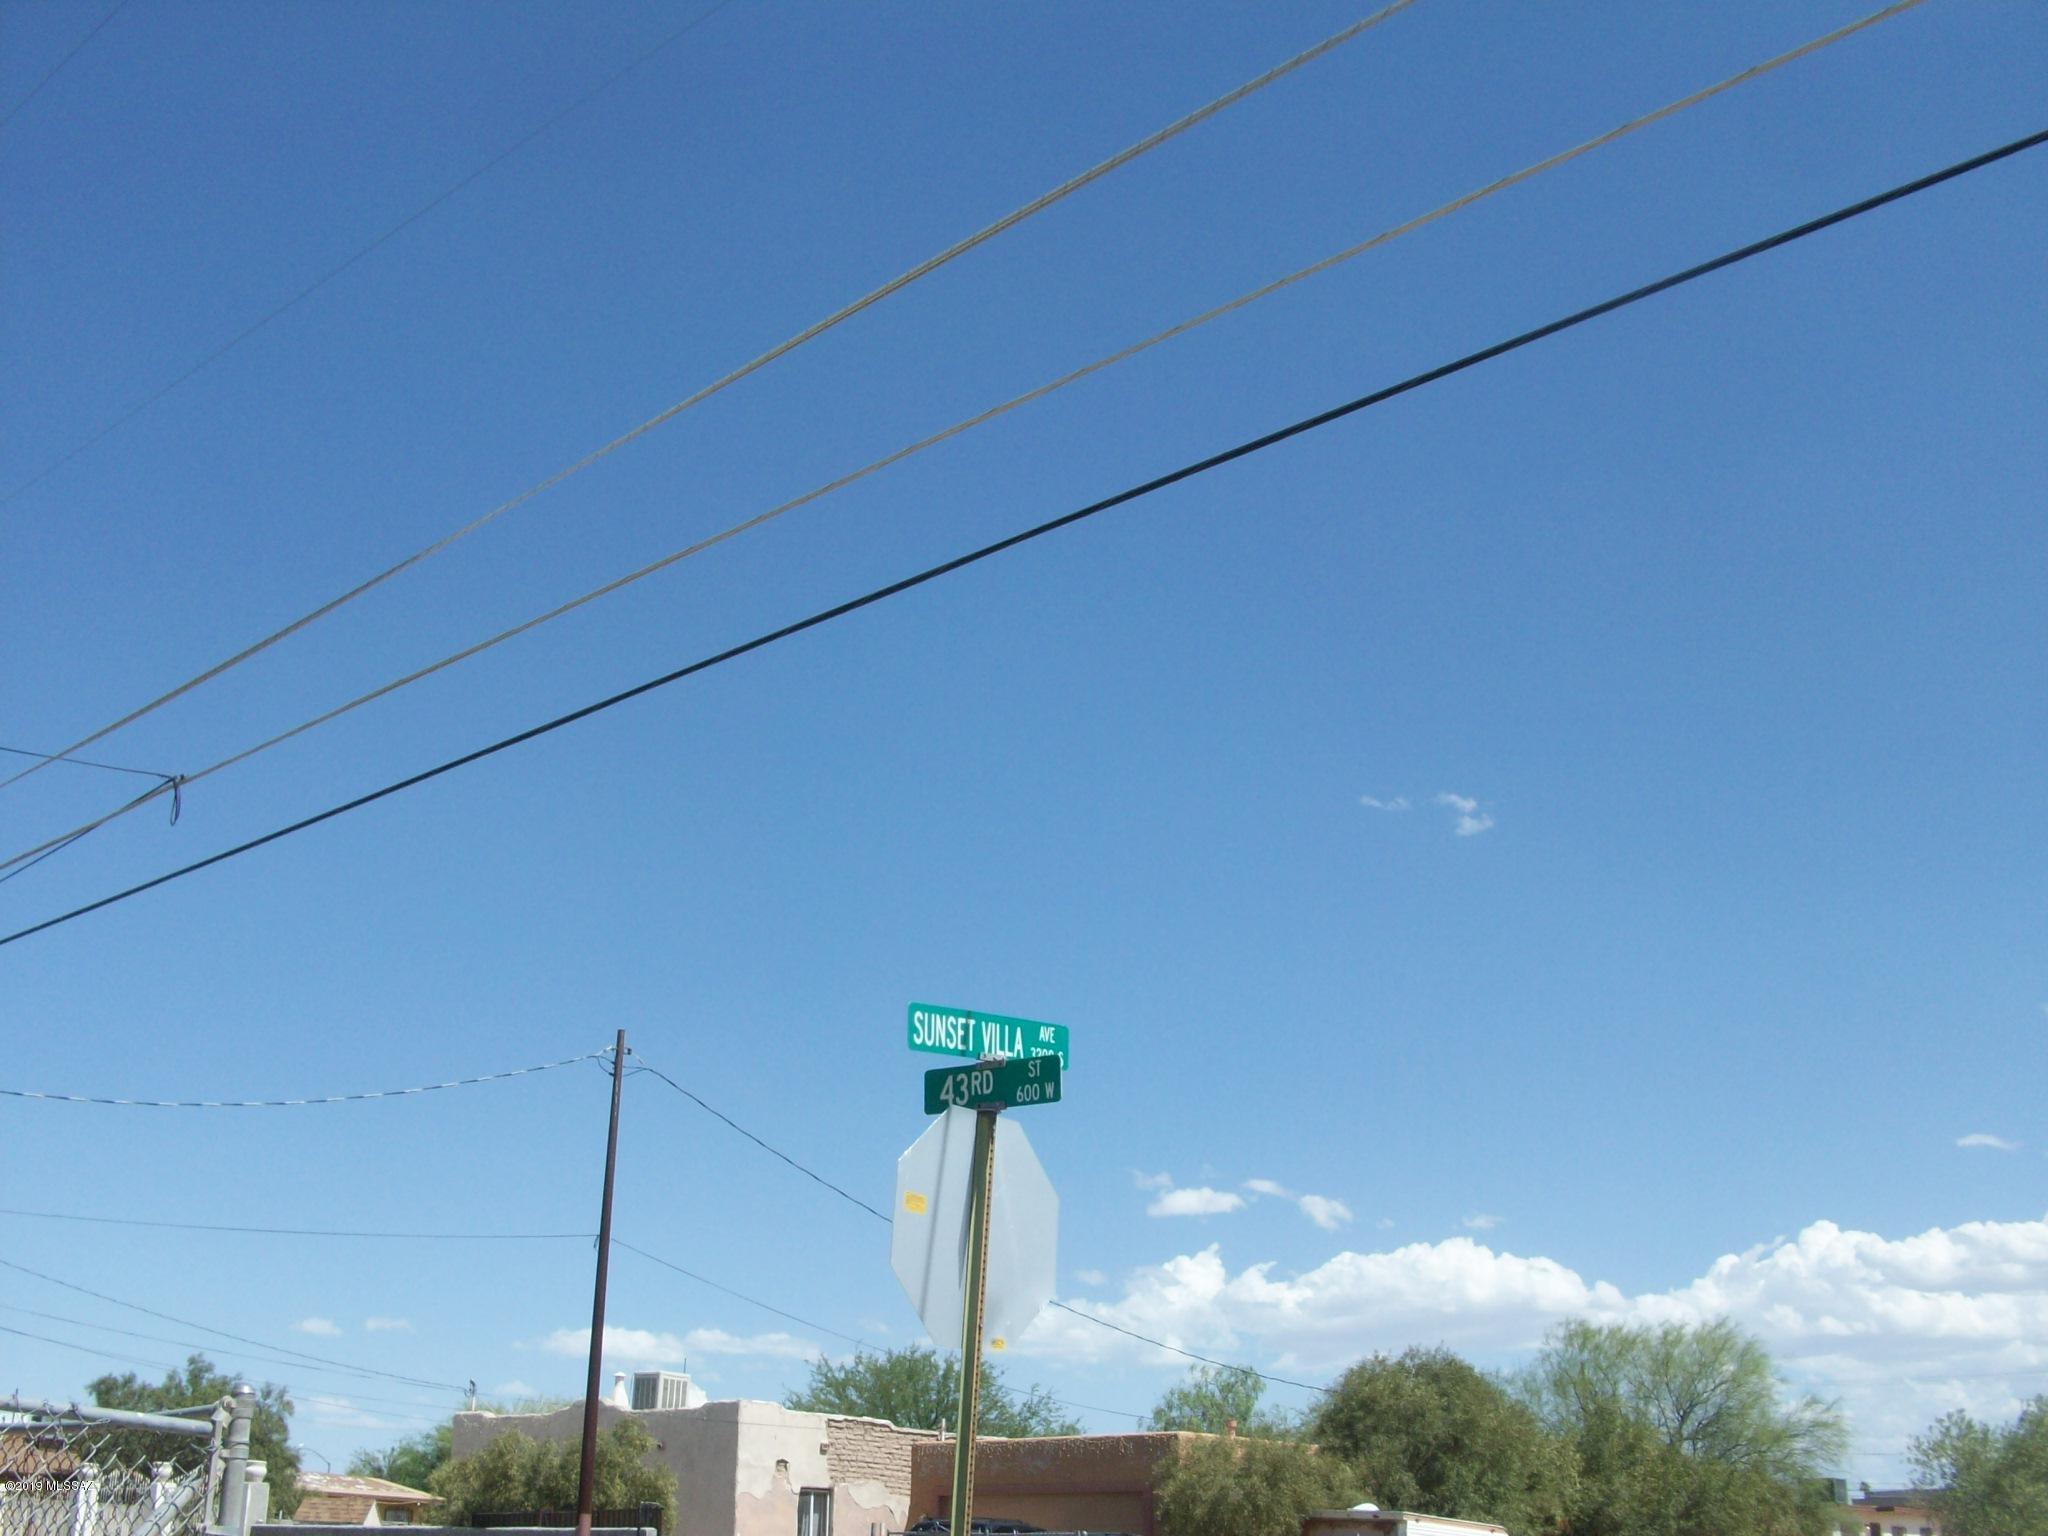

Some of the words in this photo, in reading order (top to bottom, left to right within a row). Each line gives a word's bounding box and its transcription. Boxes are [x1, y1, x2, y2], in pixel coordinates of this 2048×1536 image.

[912, 1010, 976, 1051] SUNSET
[981, 1020, 1024, 1059] VILLA
[1038, 1025, 1056, 1044] AVE
[939, 1069, 993, 1106] 43RD
[1028, 1059, 1041, 1078] ST
[1016, 1083, 1040, 1103] 600
[1044, 1081, 1055, 1099] W
